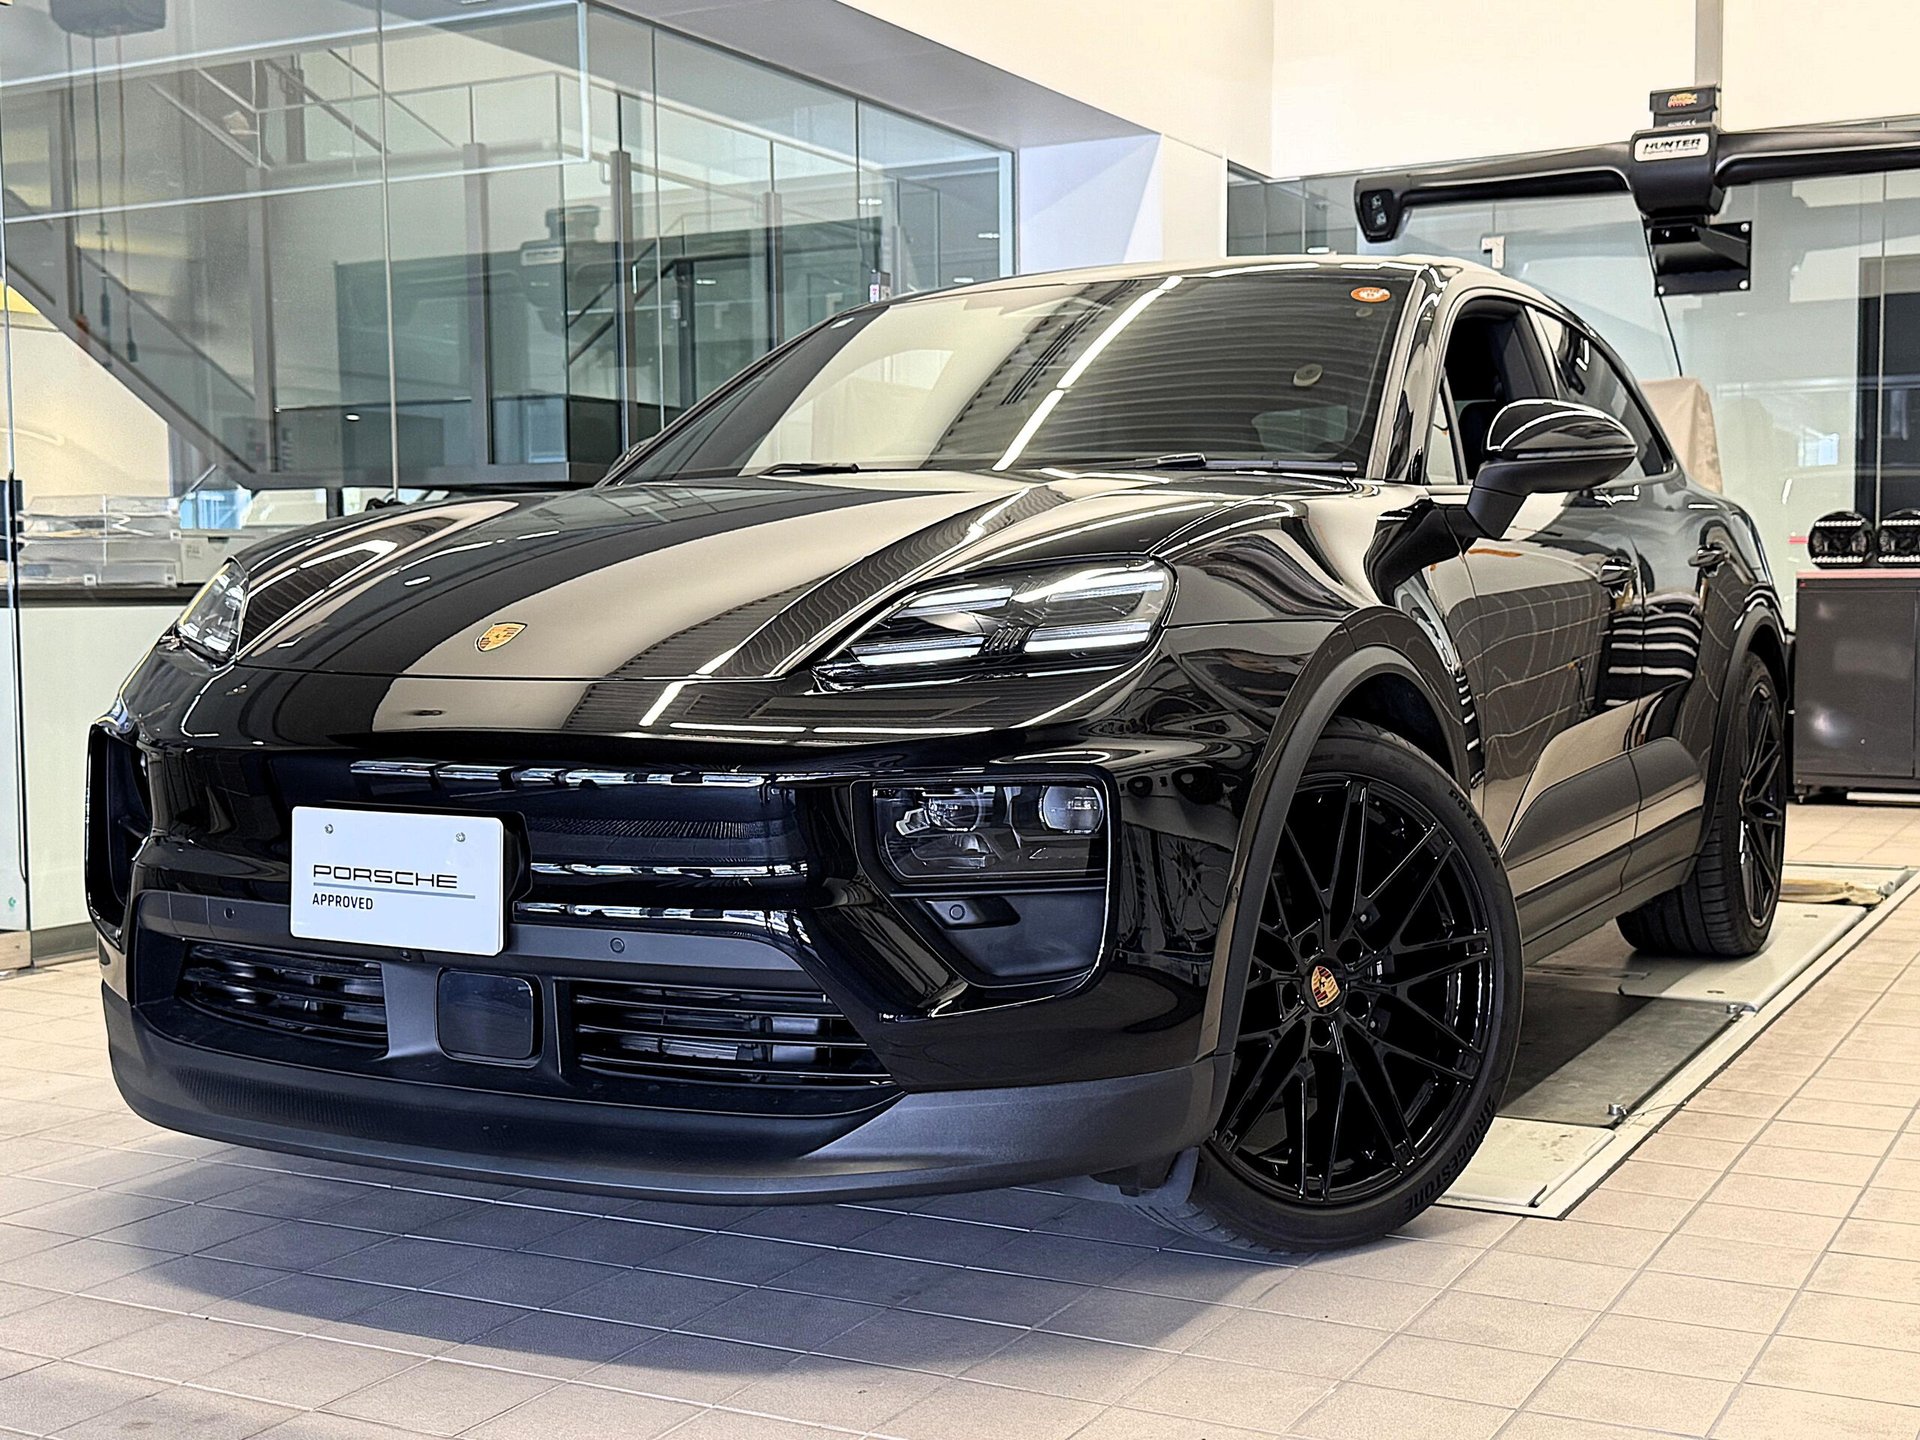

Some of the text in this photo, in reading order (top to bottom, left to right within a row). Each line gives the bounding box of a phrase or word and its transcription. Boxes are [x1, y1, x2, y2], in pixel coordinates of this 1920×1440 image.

[1644, 138, 1701, 150] HUNTER
[1448, 789, 1499, 868] POTENZA
[313, 864, 458, 889] PORSCHE
[312, 892, 373, 910] APPROVED
[1403, 1094, 1496, 1213] BRIDGESTONE
